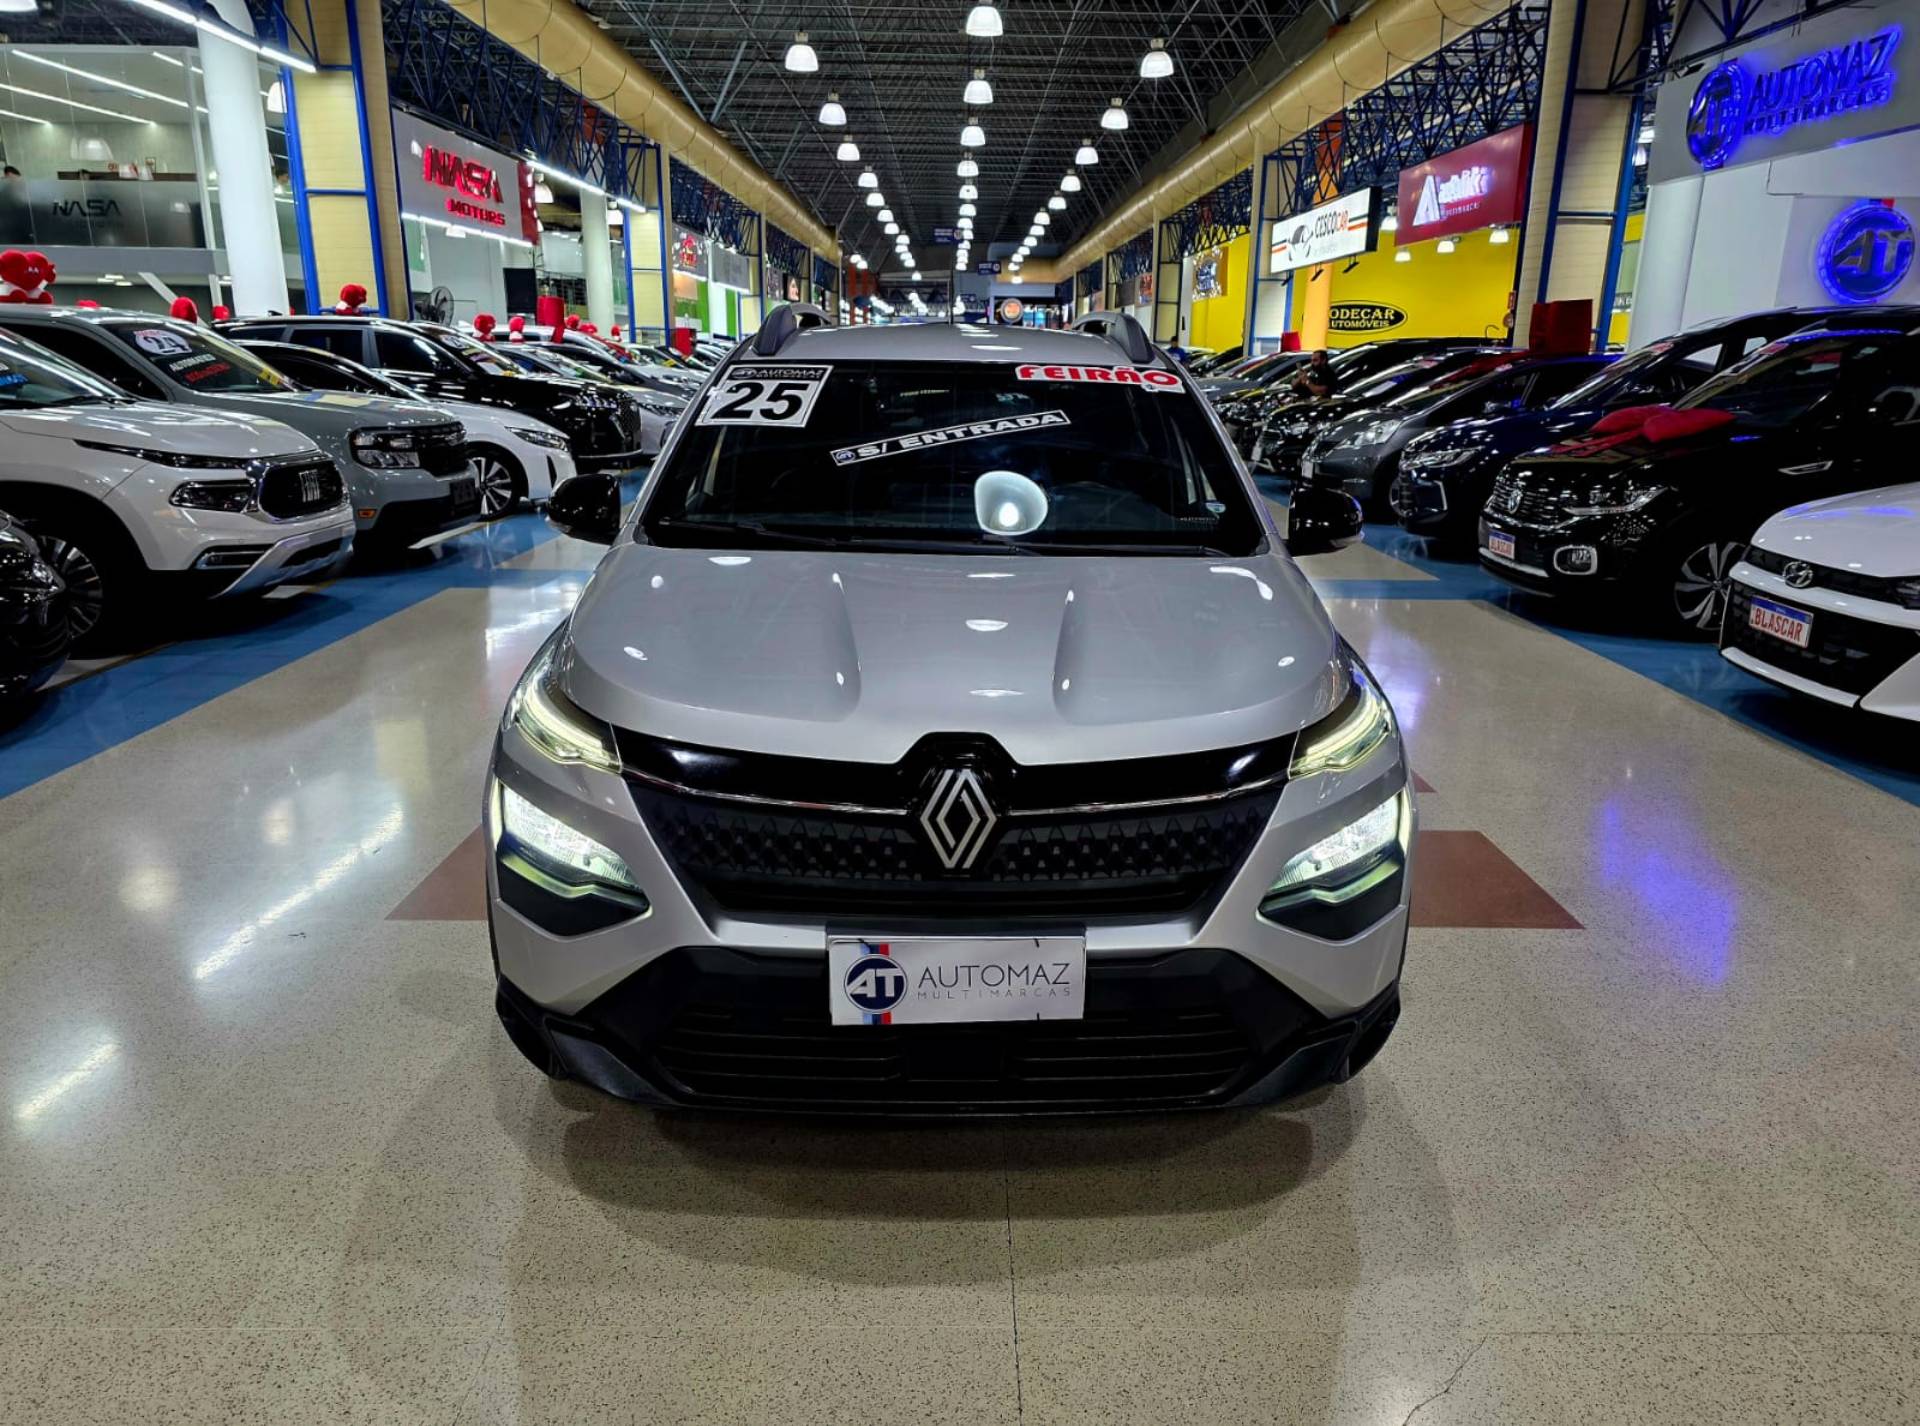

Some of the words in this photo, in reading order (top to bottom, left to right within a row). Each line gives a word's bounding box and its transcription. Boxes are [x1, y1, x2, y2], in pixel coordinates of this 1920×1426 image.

[1746, 29, 1901, 106] AUTOMAZ
[424, 146, 504, 203] NASA
[52, 199, 121, 217] NASA
[447, 199, 506, 225] MOTORS
[1315, 210, 1349, 239] CESCOCAR
[1833, 229, 1913, 273] AT
[1328, 308, 1395, 319] ODECAR
[1328, 318, 1390, 328] UTOMÓVEIS
[143, 335, 190, 354] 24
[1019, 366, 1178, 386] FEIRÃO
[710, 381, 803, 421] 25
[857, 442, 888, 458] S/
[898, 413, 1066, 449] ENTRADA
[1755, 607, 1803, 642] BLASCAR
[846, 967, 904, 999] AT
[918, 963, 1071, 989] AUTOMAZ
[917, 987, 1071, 1000] MULTIMARCAS
